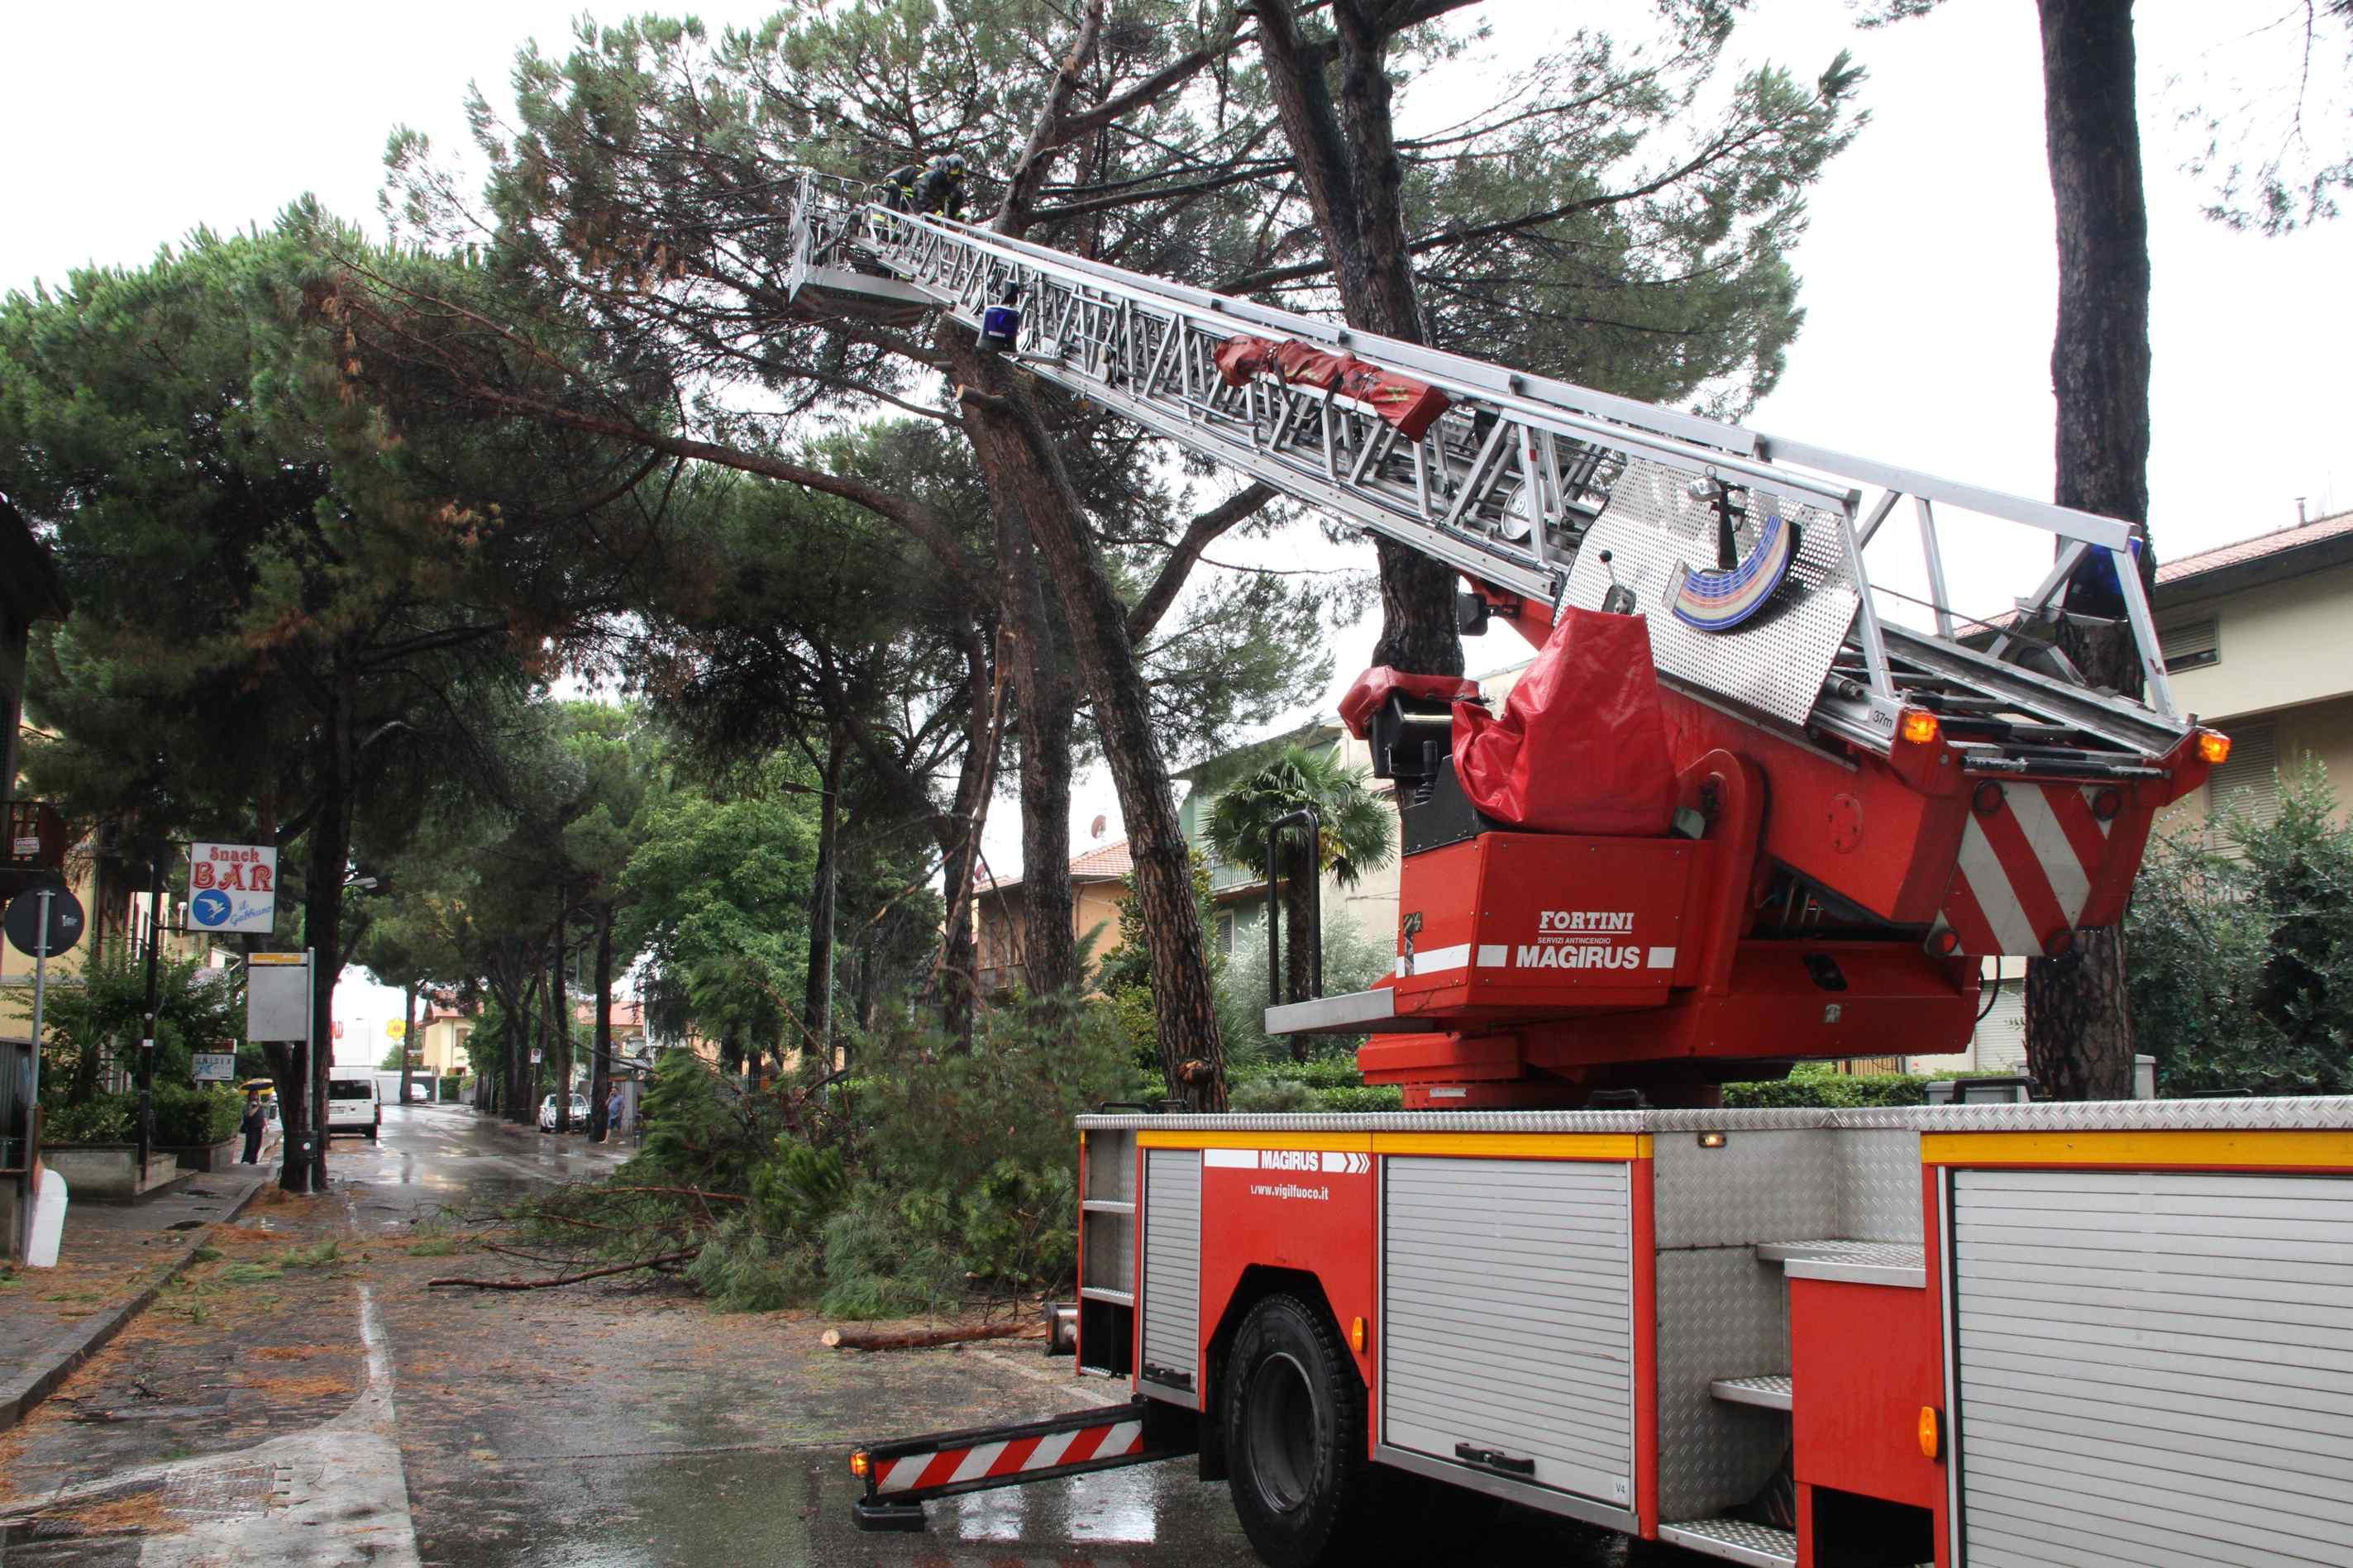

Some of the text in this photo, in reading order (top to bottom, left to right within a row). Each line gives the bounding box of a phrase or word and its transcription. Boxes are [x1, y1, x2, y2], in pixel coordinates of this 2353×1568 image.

[1873, 710, 1892, 728] 37m
[210, 846, 260, 862] Snack
[193, 860, 274, 892] BAR
[1539, 911, 1635, 930] FORTINI
[1515, 945, 1641, 970] MAGIRUS
[1261, 1150, 1320, 1172] MAGIRUS
